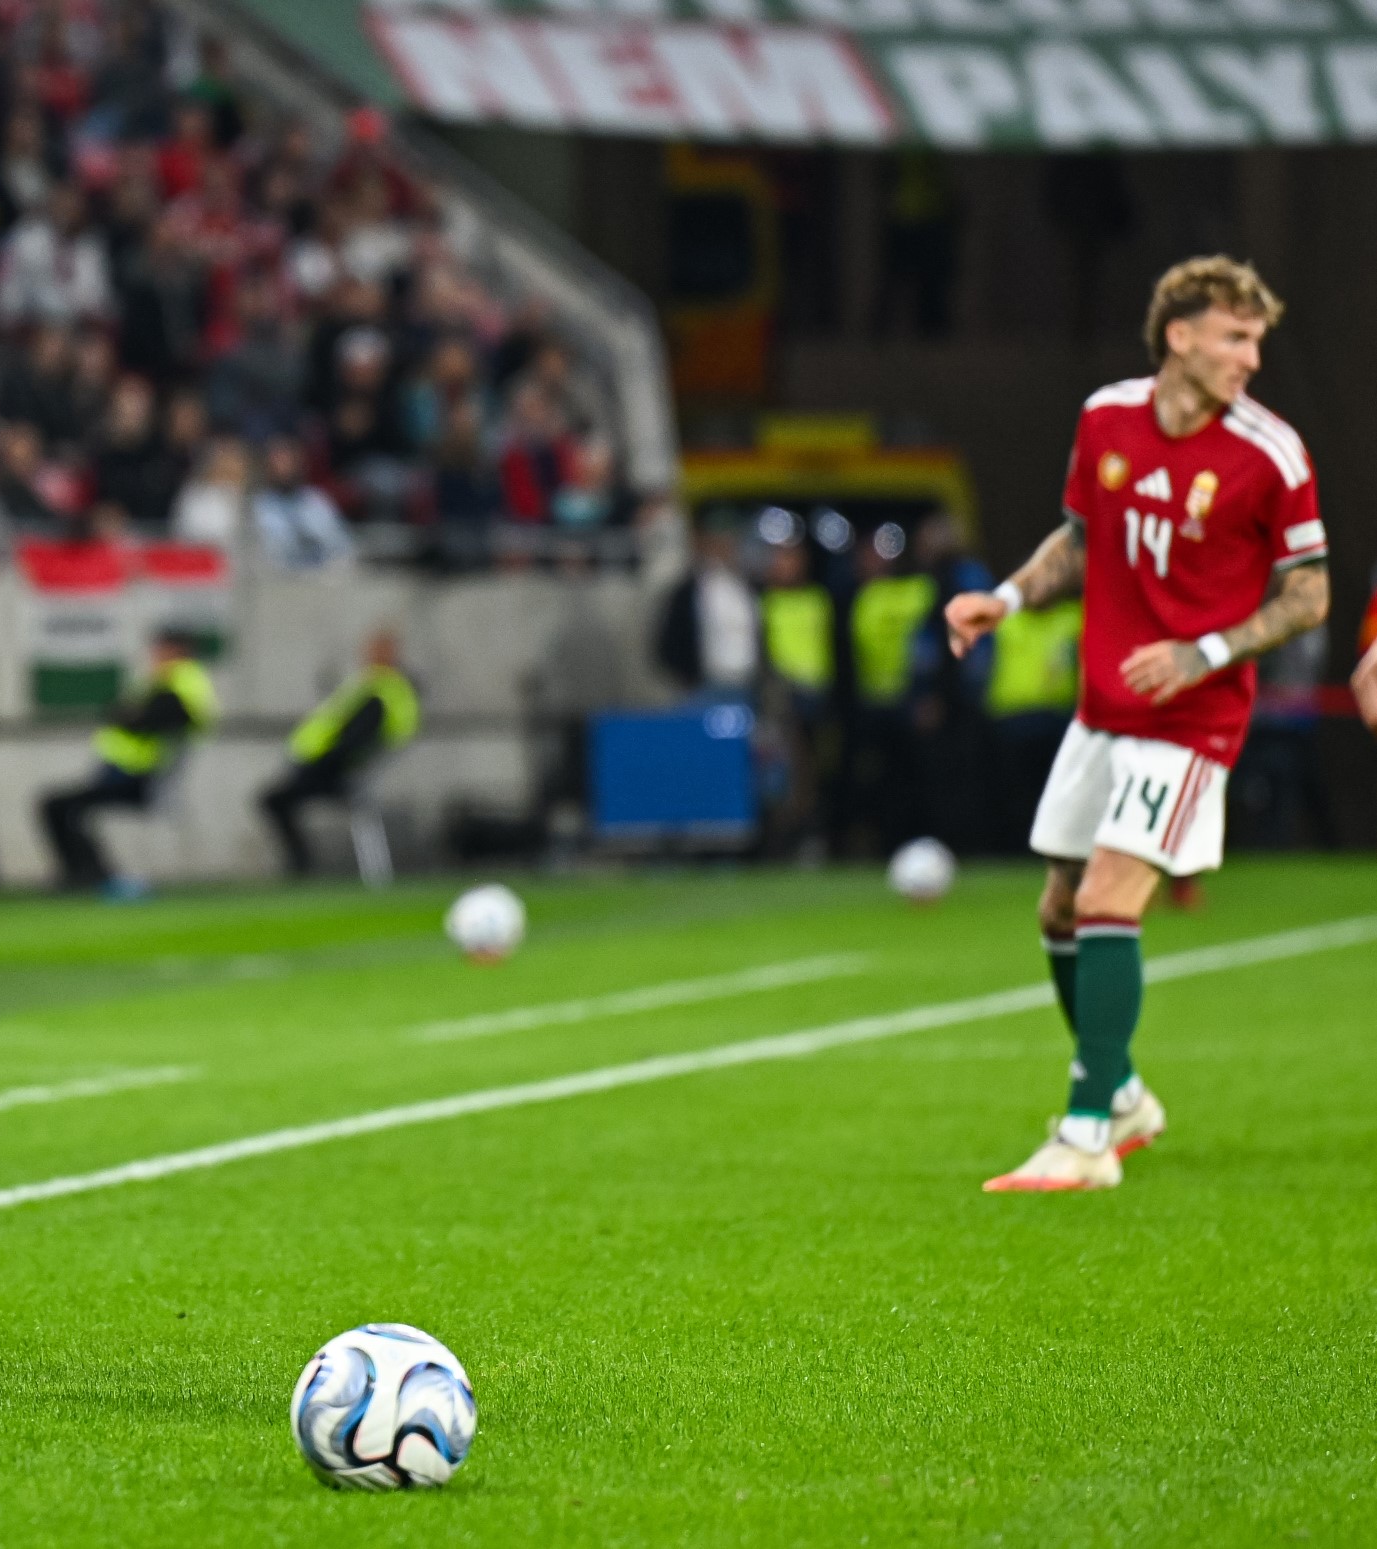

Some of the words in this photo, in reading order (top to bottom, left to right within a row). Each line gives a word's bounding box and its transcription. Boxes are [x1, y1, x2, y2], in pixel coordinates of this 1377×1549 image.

[376, 20, 888, 142] NEM
[1124, 507, 1173, 579] 14
[1113, 774, 1168, 832] 14
